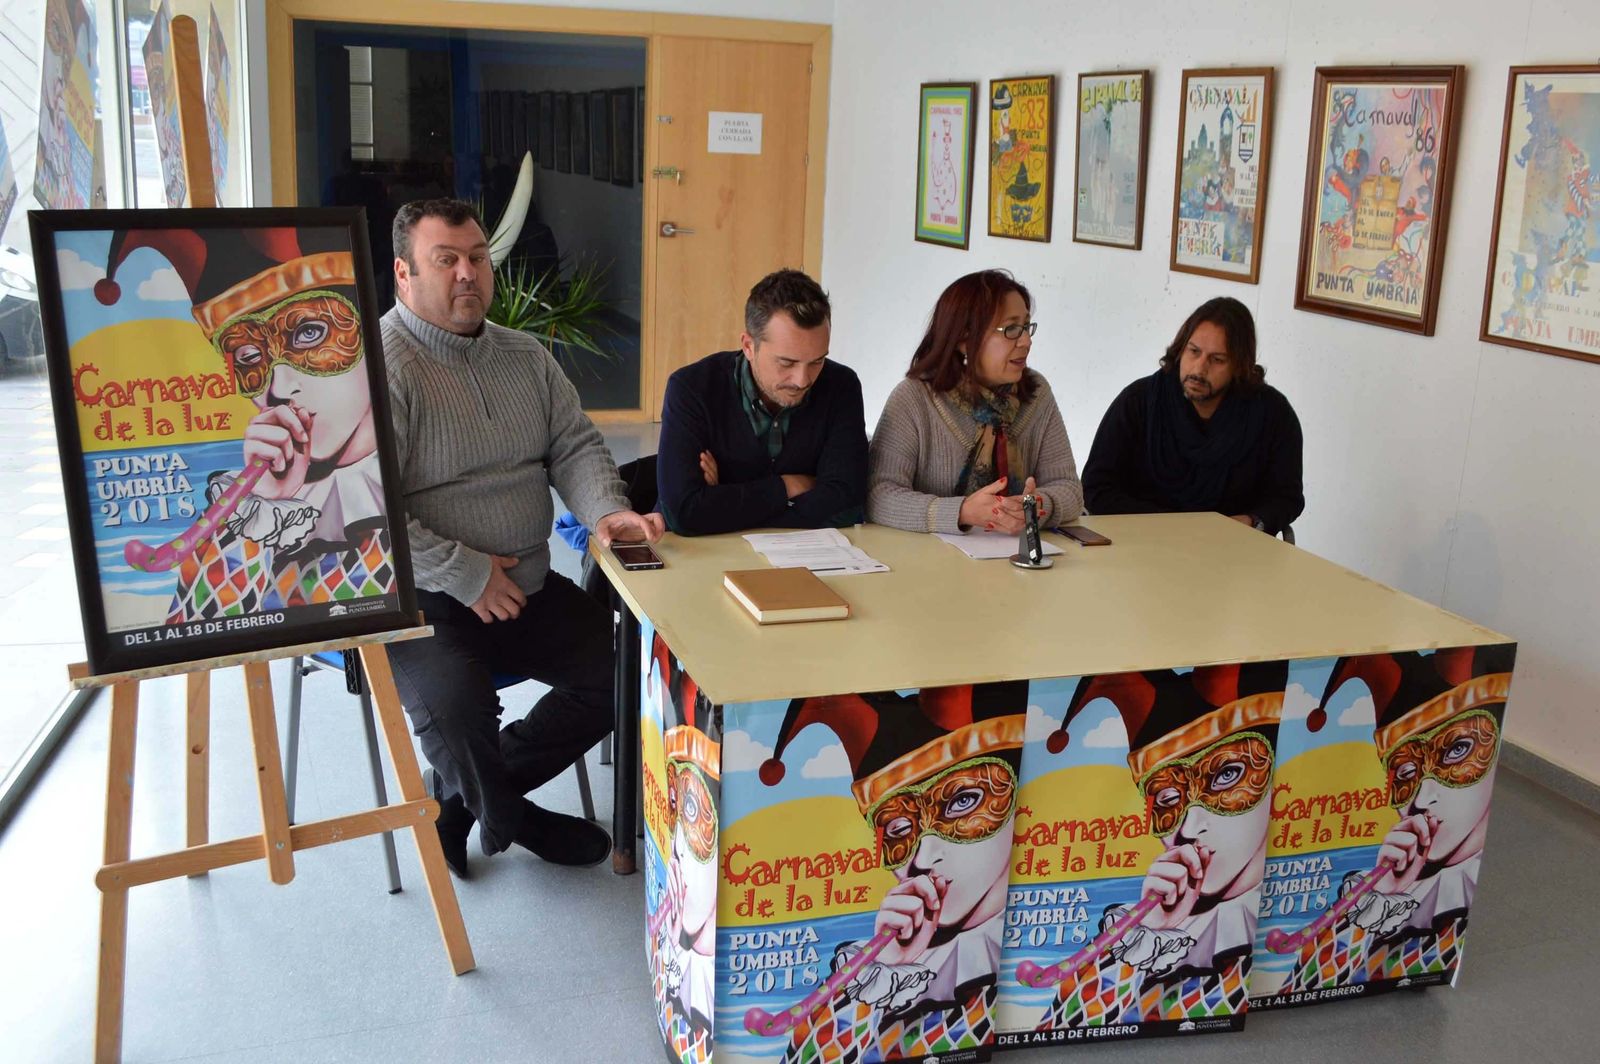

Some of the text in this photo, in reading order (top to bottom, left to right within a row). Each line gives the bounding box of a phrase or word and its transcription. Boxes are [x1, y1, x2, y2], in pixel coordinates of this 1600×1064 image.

[1344, 98, 1418, 138] Carnaval
[1415, 127, 1436, 153] 86
[1316, 271, 1418, 305] PUNTA UMBRIA
[72, 351, 237, 409] Carnaval
[94, 403, 232, 441] de la luz
[94, 452, 189, 478] PUNTA
[96, 470, 195, 501] UMBRÍA
[101, 494, 196, 527] 2018
[125, 612, 285, 646] DEL 1 AL 18 DE FEBRERO
[1270, 768, 1395, 821] Carnaval
[1012, 795, 1155, 847] Carnaval
[1272, 814, 1379, 849] de la luz
[721, 826, 884, 887] Carnaval
[1015, 843, 1140, 877] de la luz
[1264, 856, 1333, 879] PUNTA
[735, 879, 871, 918] de la luz
[1008, 887, 1090, 907] PUNTA
[1261, 871, 1330, 897] UMBRÍA
[1006, 902, 1089, 927] UMBRÍA
[1258, 892, 1328, 918] 2018
[729, 926, 820, 951] PUNTA
[1004, 923, 1087, 949] 2018
[728, 943, 820, 972] UMBRÍA
[728, 965, 819, 996] 2018
[1266, 998, 1272, 1006] 1
[1274, 996, 1287, 1005] AL
[1289, 993, 1302, 1003] 18
[1304, 991, 1317, 1001] DE
[1319, 984, 1365, 1000] FEBRERO
[998, 1025, 1139, 1045] DEL 1 AL 18 DE FEBRERO
